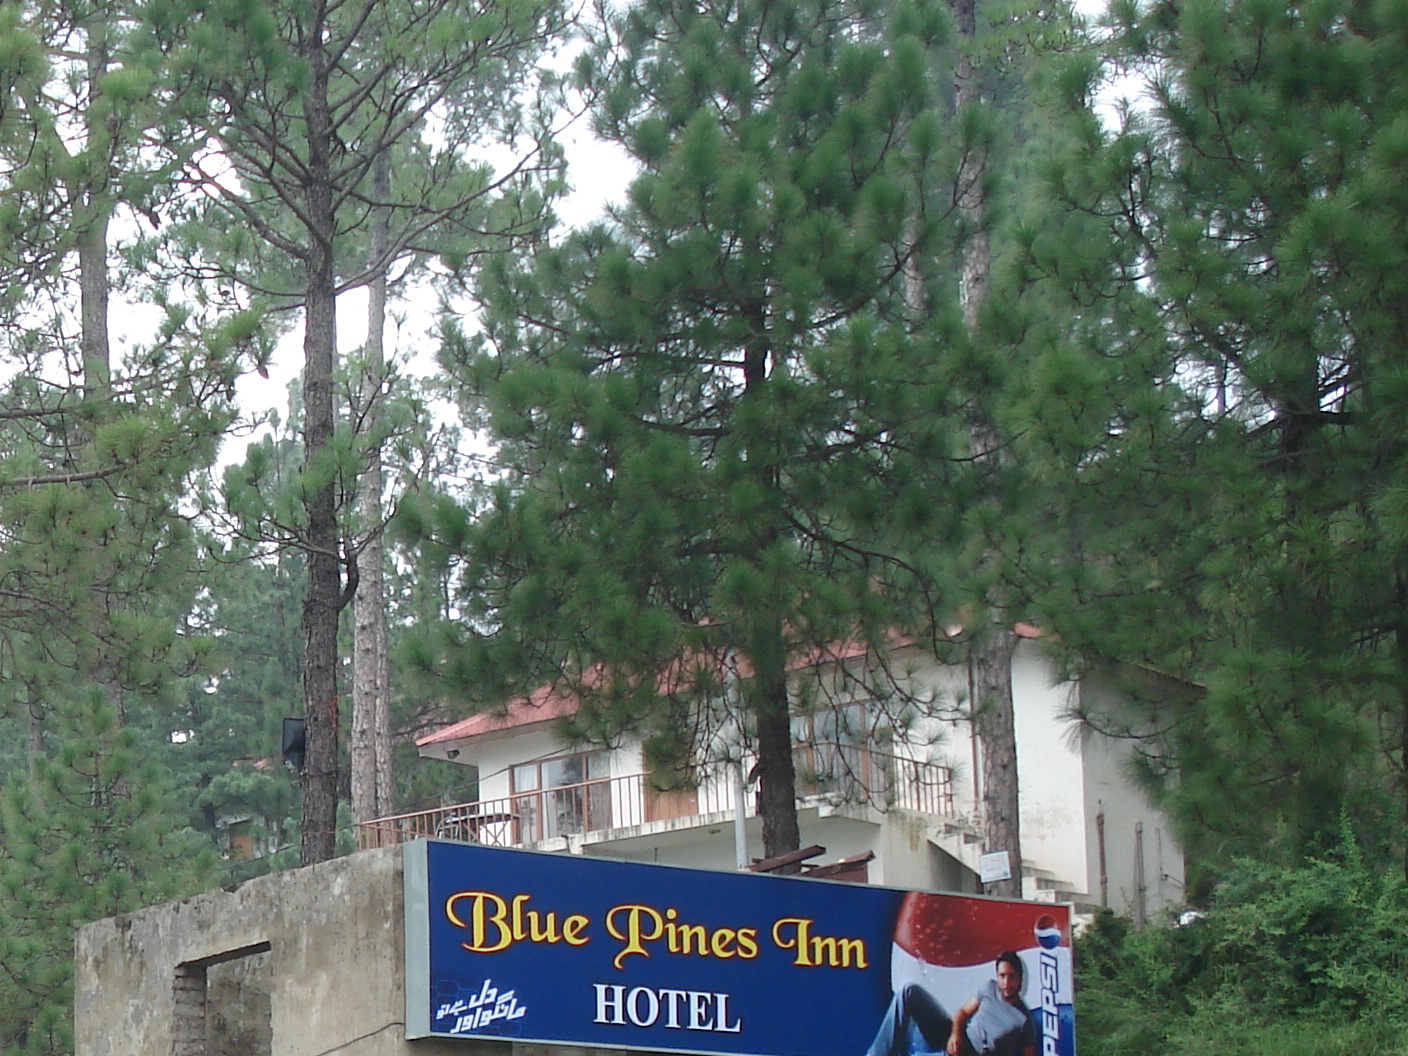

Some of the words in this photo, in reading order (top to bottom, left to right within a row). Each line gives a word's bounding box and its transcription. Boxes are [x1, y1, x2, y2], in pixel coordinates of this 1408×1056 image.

[445, 891, 589, 953] Blue
[605, 904, 758, 969] Pines
[772, 917, 868, 969] Inn
[592, 983, 742, 1033] HOTEL
